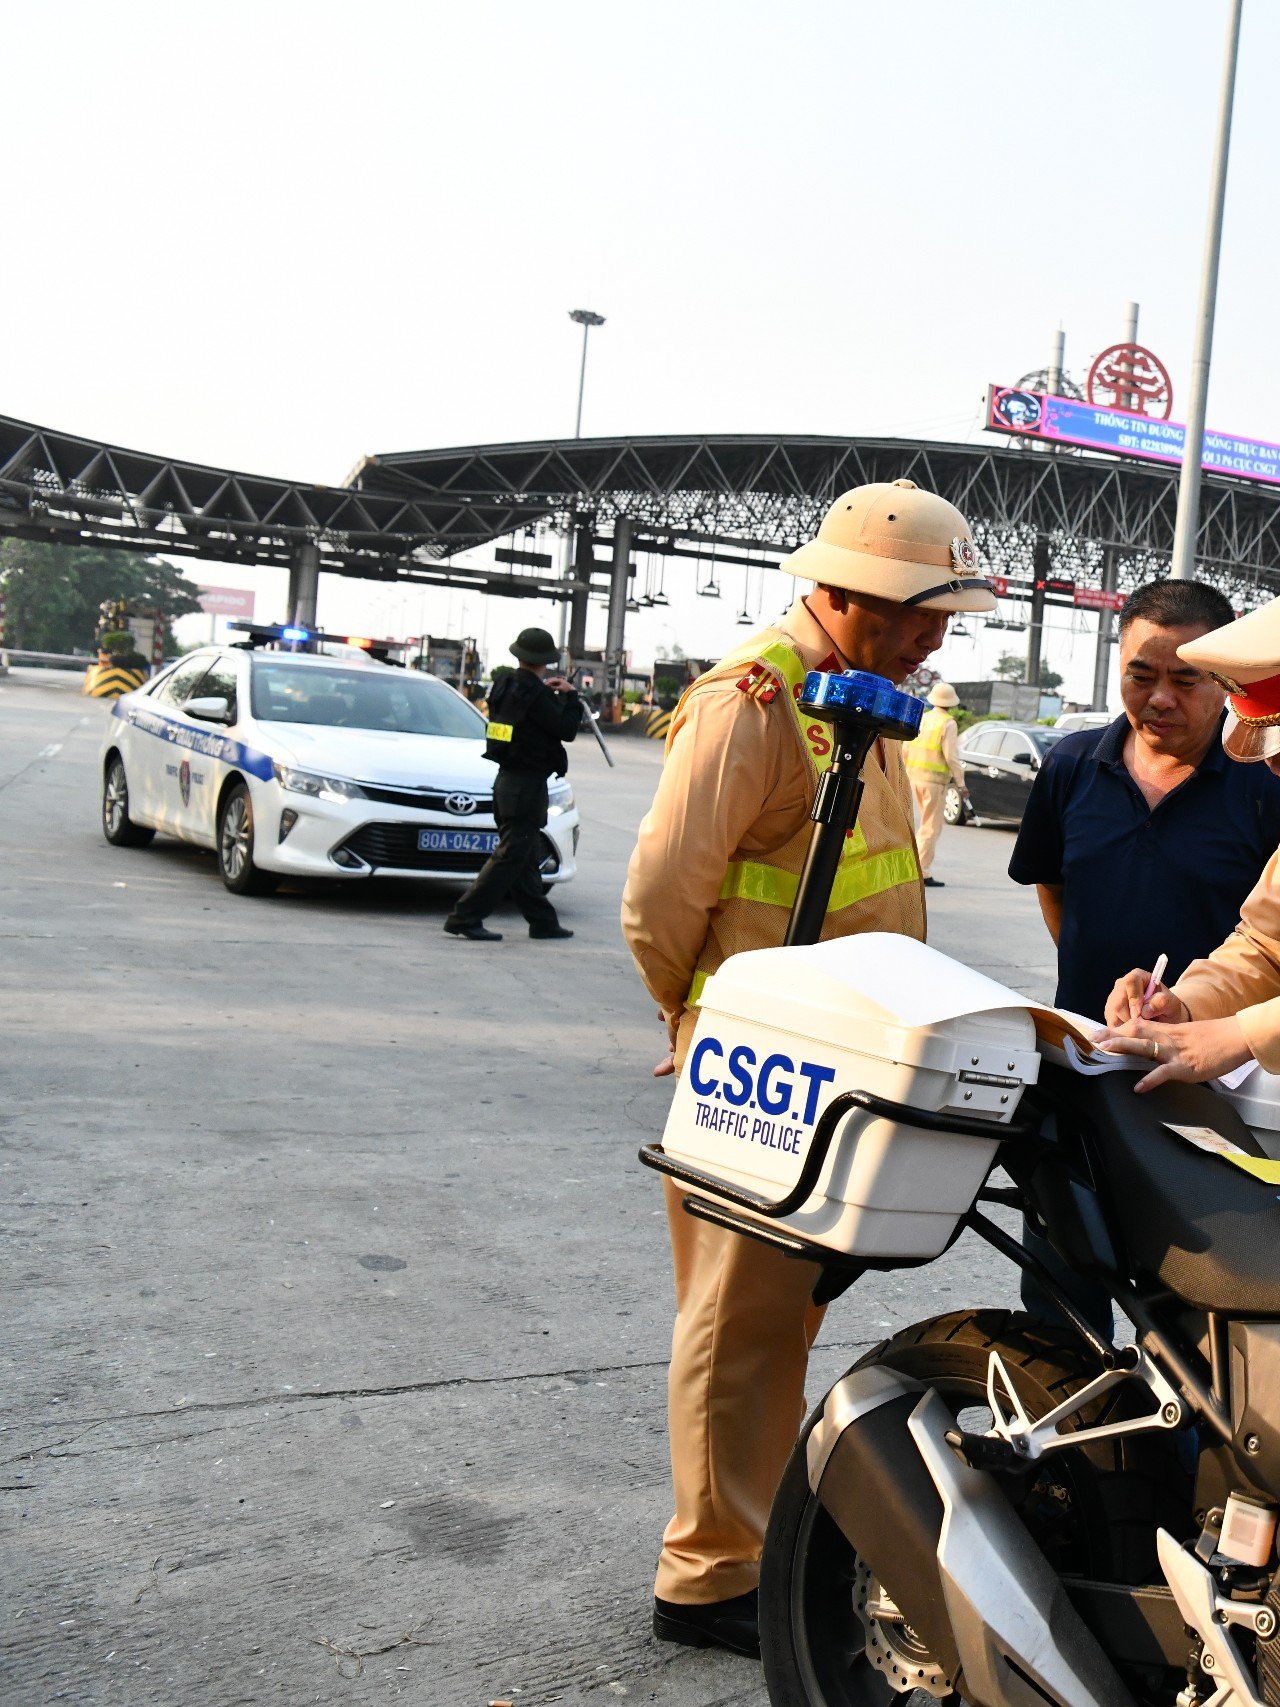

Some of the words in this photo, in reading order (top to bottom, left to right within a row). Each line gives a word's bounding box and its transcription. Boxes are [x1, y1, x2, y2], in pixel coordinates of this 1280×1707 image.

[1130, 420, 1147, 433] TIN
[1259, 447, 1278, 460] BAN
[1253, 462, 1277, 475] CSGT
[690, 1037, 836, 1126] C.S.G.T
[696, 1102, 748, 1139] TRAFFIC
[751, 1118, 803, 1154] POLICE
